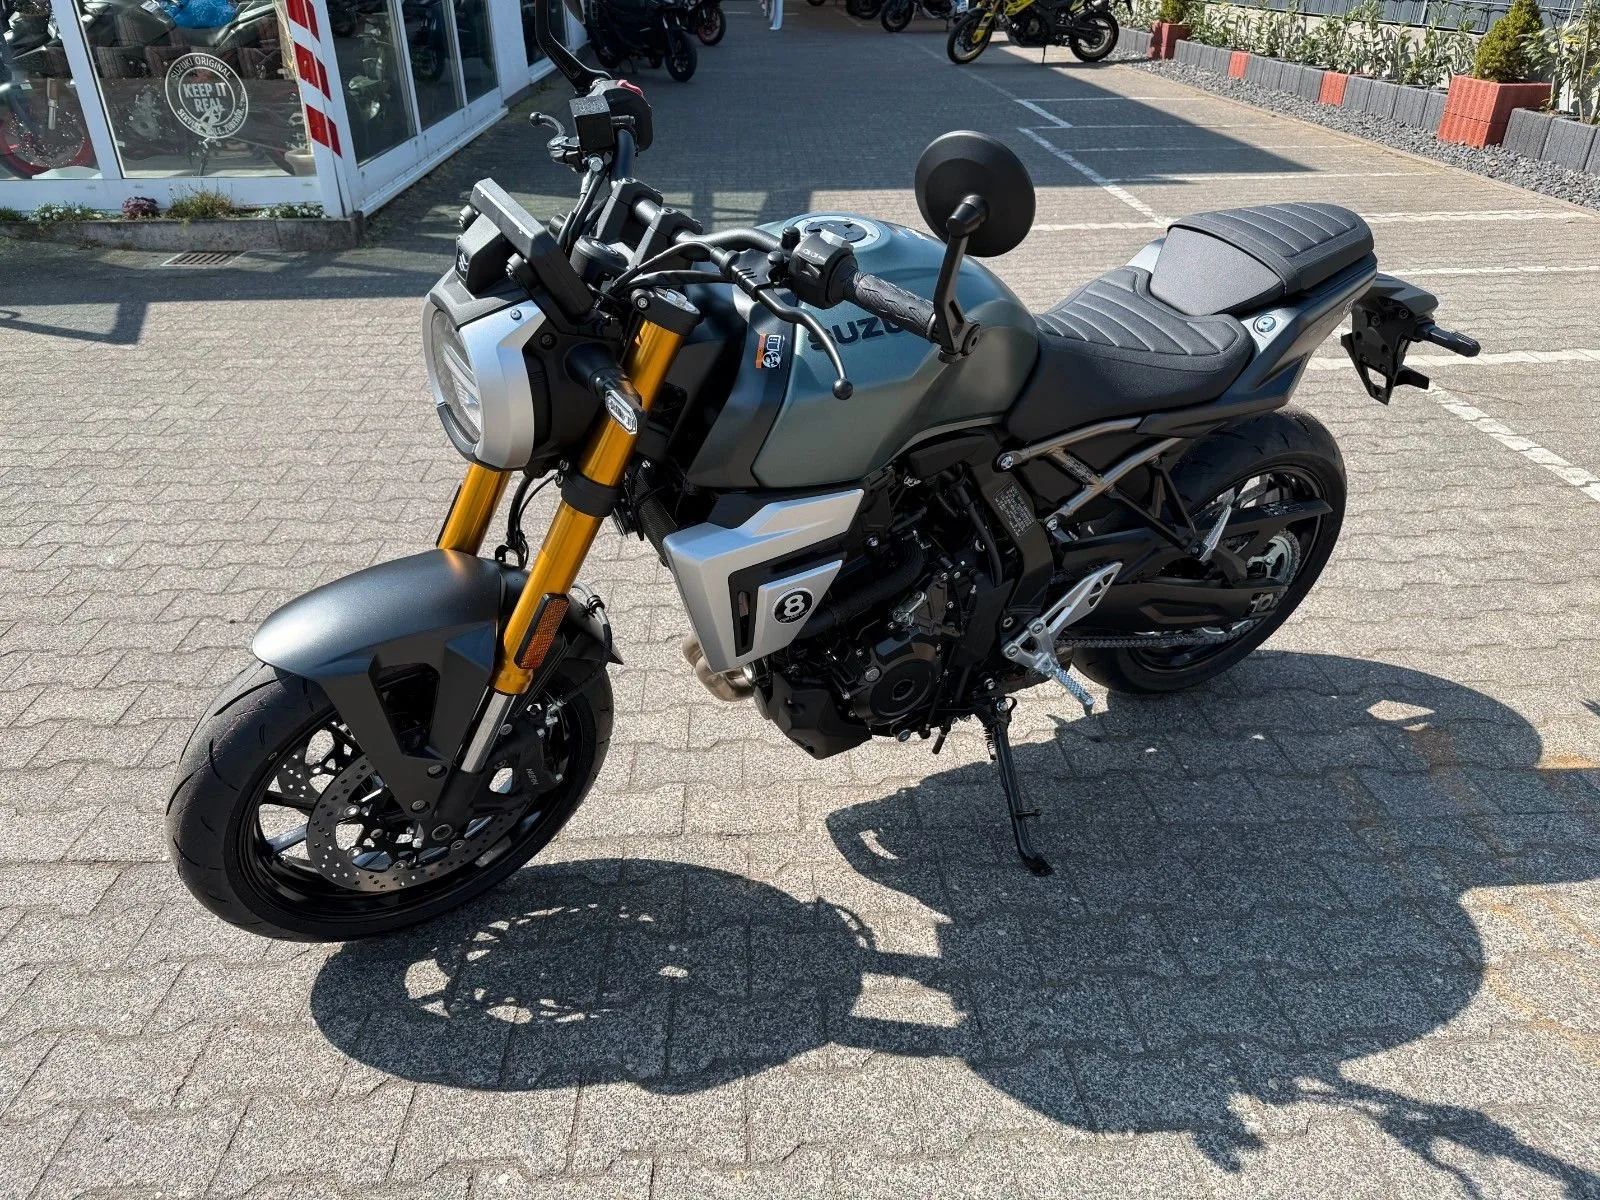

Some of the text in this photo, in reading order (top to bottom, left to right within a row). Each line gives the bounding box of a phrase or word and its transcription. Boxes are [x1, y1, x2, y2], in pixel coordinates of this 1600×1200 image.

[171, 56, 232, 80] SUZUKI ORIGINAL
[183, 82, 227, 98] KEEP IT
[193, 97, 223, 113] REAL
[783, 594, 805, 617] 8
